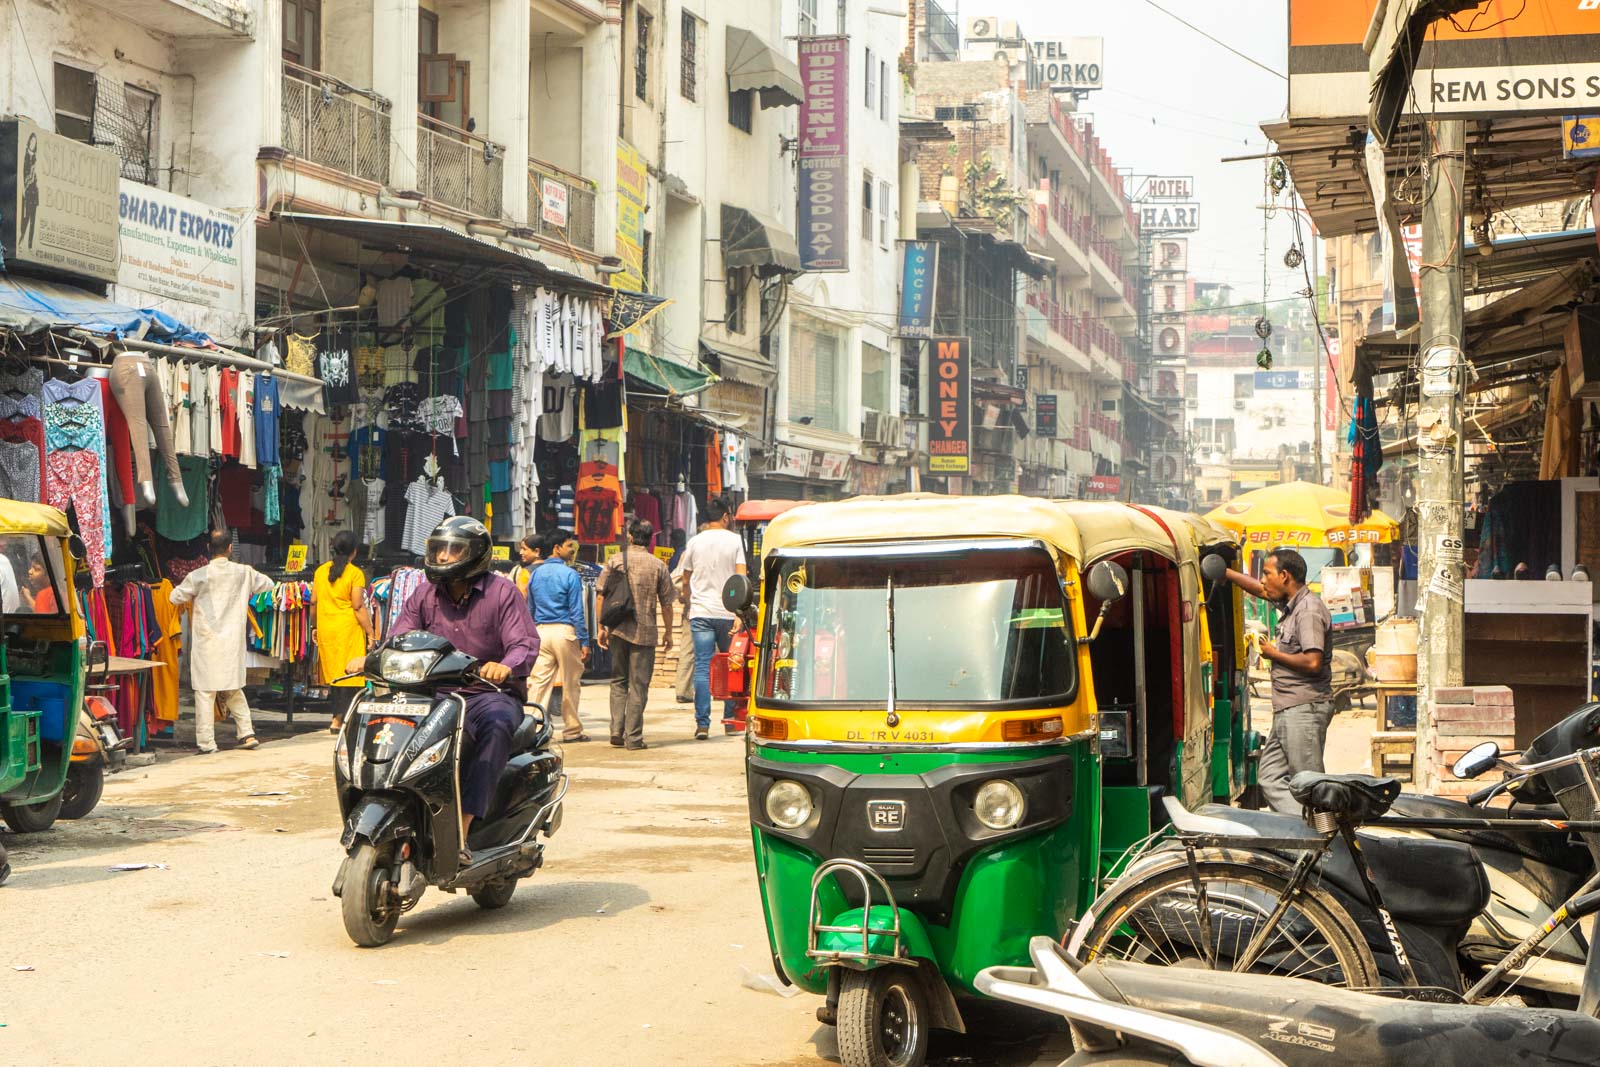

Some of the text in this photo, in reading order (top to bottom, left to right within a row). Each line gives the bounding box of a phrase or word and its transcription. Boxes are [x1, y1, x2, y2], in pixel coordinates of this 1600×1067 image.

[802, 42, 840, 54] HOTEL
[1034, 42, 1067, 58] TEL
[806, 55, 836, 138] DECENT
[1496, 77, 1575, 100] SONS
[802, 158, 841, 170] COTTAGE
[1148, 180, 1190, 196] HOTEL
[46, 186, 113, 225] BOUTIQUE
[810, 170, 833, 255] GOOD DAY
[118, 192, 234, 248] BHARAT EXPORTS
[1142, 208, 1196, 228] HARI
[167, 237, 196, 256] Exporters
[938, 342, 959, 437] MONEY
[543, 386, 566, 413] DJ
[930, 440, 967, 454] CHANGER
[847, 731, 934, 740] DL 1R V 4031
[875, 811, 899, 824] RE
[1379, 908, 1408, 966] ATLAS
[1260, 1032, 1320, 1050] Activa
